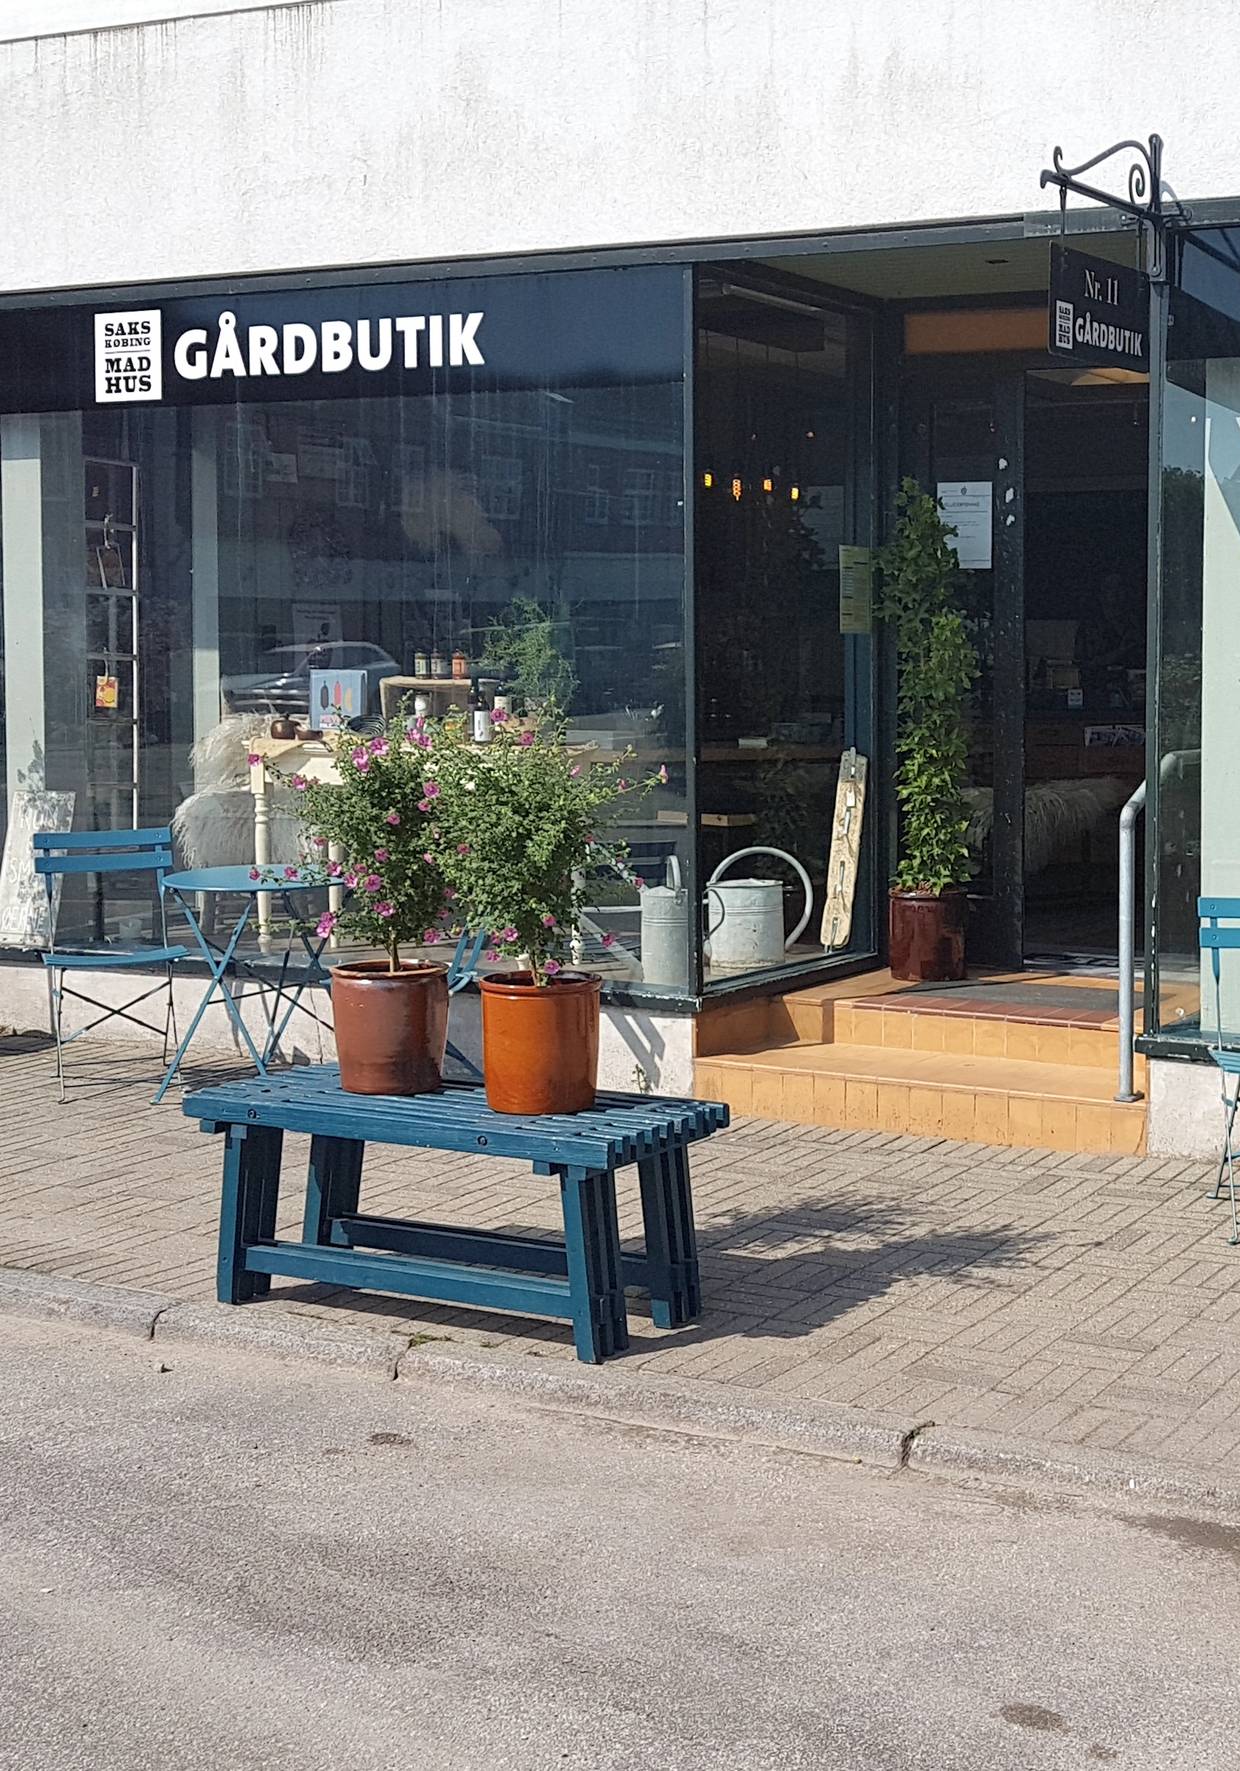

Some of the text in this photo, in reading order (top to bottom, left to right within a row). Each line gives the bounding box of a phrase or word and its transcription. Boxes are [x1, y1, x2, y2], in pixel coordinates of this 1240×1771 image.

[1084, 269, 1102, 301] Nr.
[104, 320, 151, 336] SAKS
[1075, 312, 1142, 357] GÅRDBUTIK
[104, 337, 151, 348] KØBING
[174, 311, 485, 380] GÅRDBUTIK
[105, 356, 151, 373] MAD
[105, 375, 152, 393] HUS
